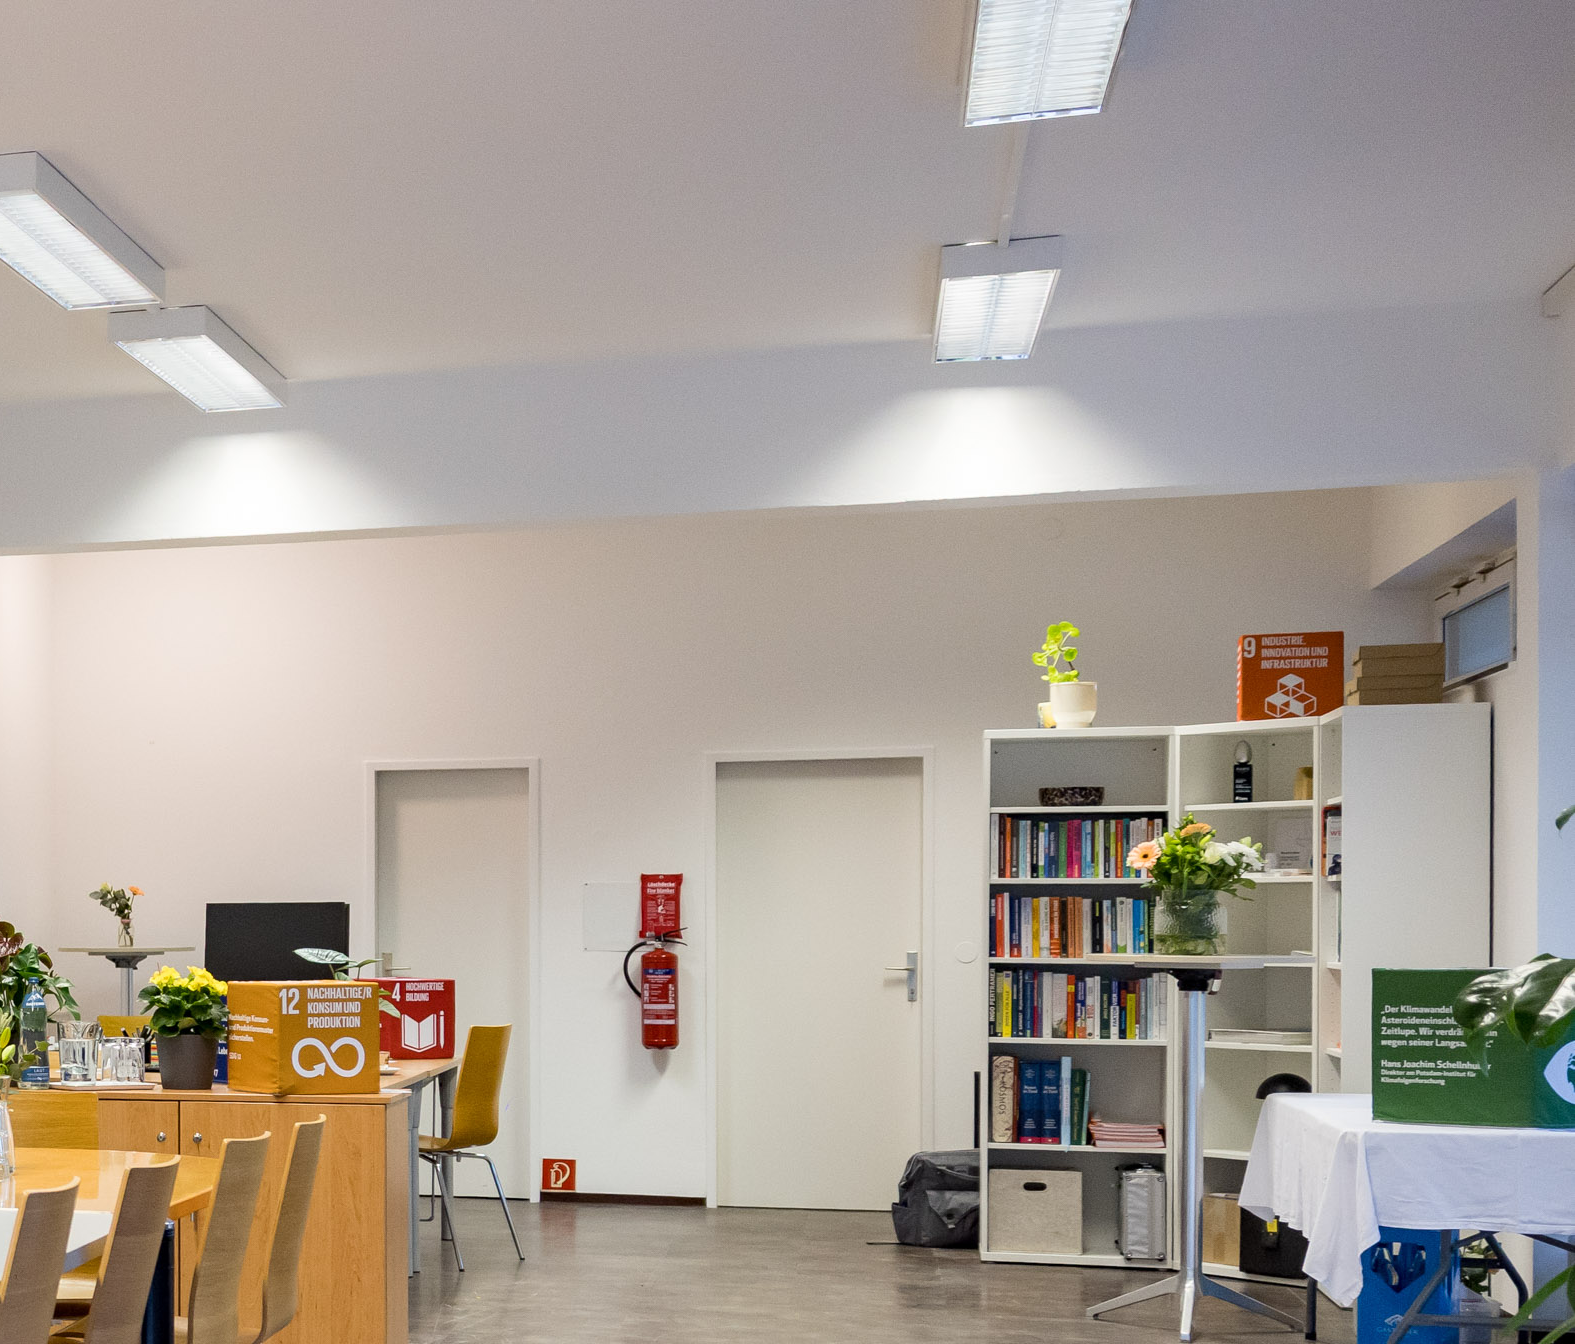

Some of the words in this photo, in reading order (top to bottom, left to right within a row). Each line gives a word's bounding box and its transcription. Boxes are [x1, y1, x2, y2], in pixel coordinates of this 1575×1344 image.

[1244, 637, 1256, 658] 9
[1262, 647, 1309, 658] INNOVATION
[1311, 647, 1328, 655] UND
[1261, 658, 1328, 669] INFRASTRUKTUR
[406, 982, 444, 991] HOCHWERTIGE
[307, 987, 372, 1000] NACHHALTIGE/R
[392, 983, 401, 1002] 4
[406, 993, 429, 1002] BILDUNG
[279, 988, 300, 1015] 12
[307, 1002, 343, 1014] KONSUM
[344, 1001, 361, 1013] UND
[1381, 1006, 1399, 1014] „Der
[307, 1016, 361, 1029] PRODUKTION
[1381, 1027, 1417, 1037] Zeitlupe.
[1435, 1028, 1464, 1036] verdrä
[1381, 1040, 1407, 1048] wegen
[1403, 1060, 1435, 1068] Joachim
[1437, 1061, 1491, 1069] Schellnhur
[1381, 1077, 1445, 1085] Klimafolgenforschung
